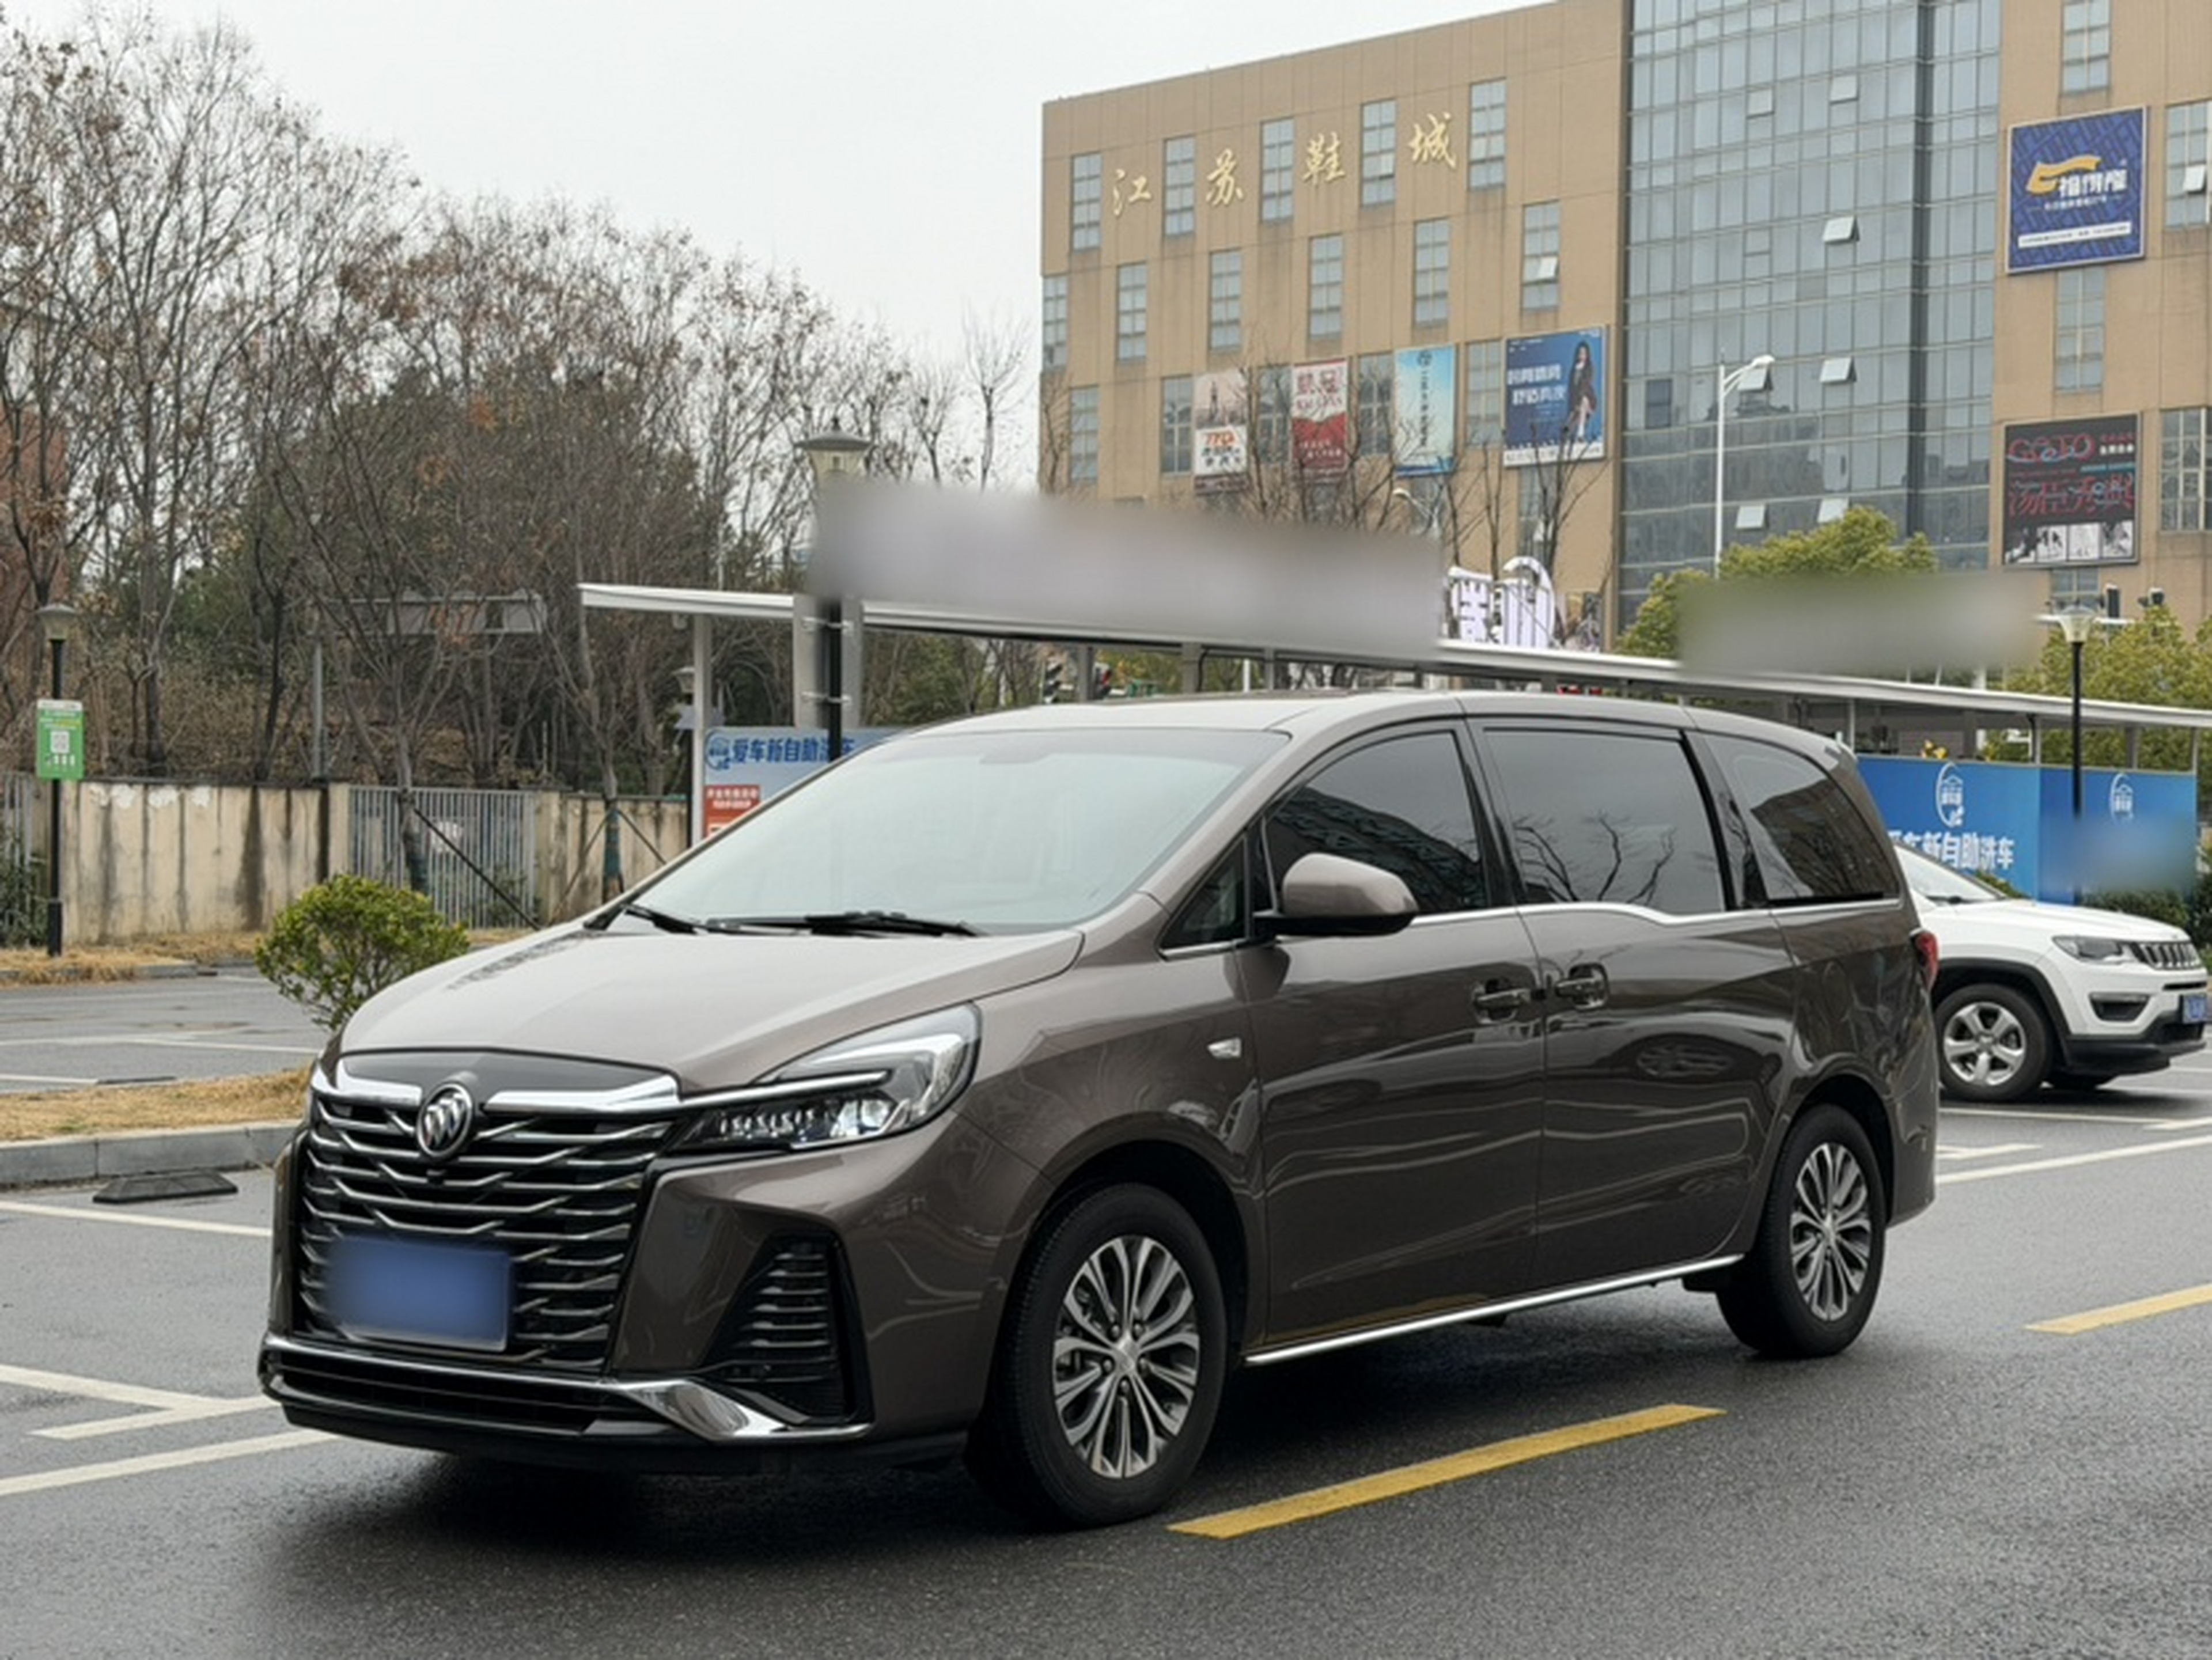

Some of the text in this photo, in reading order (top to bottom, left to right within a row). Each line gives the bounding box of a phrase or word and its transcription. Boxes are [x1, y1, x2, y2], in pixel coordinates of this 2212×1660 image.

[1113, 113, 1457, 217] 江苏鞋城
[1888, 830, 2014, 870] 新自助洗车
